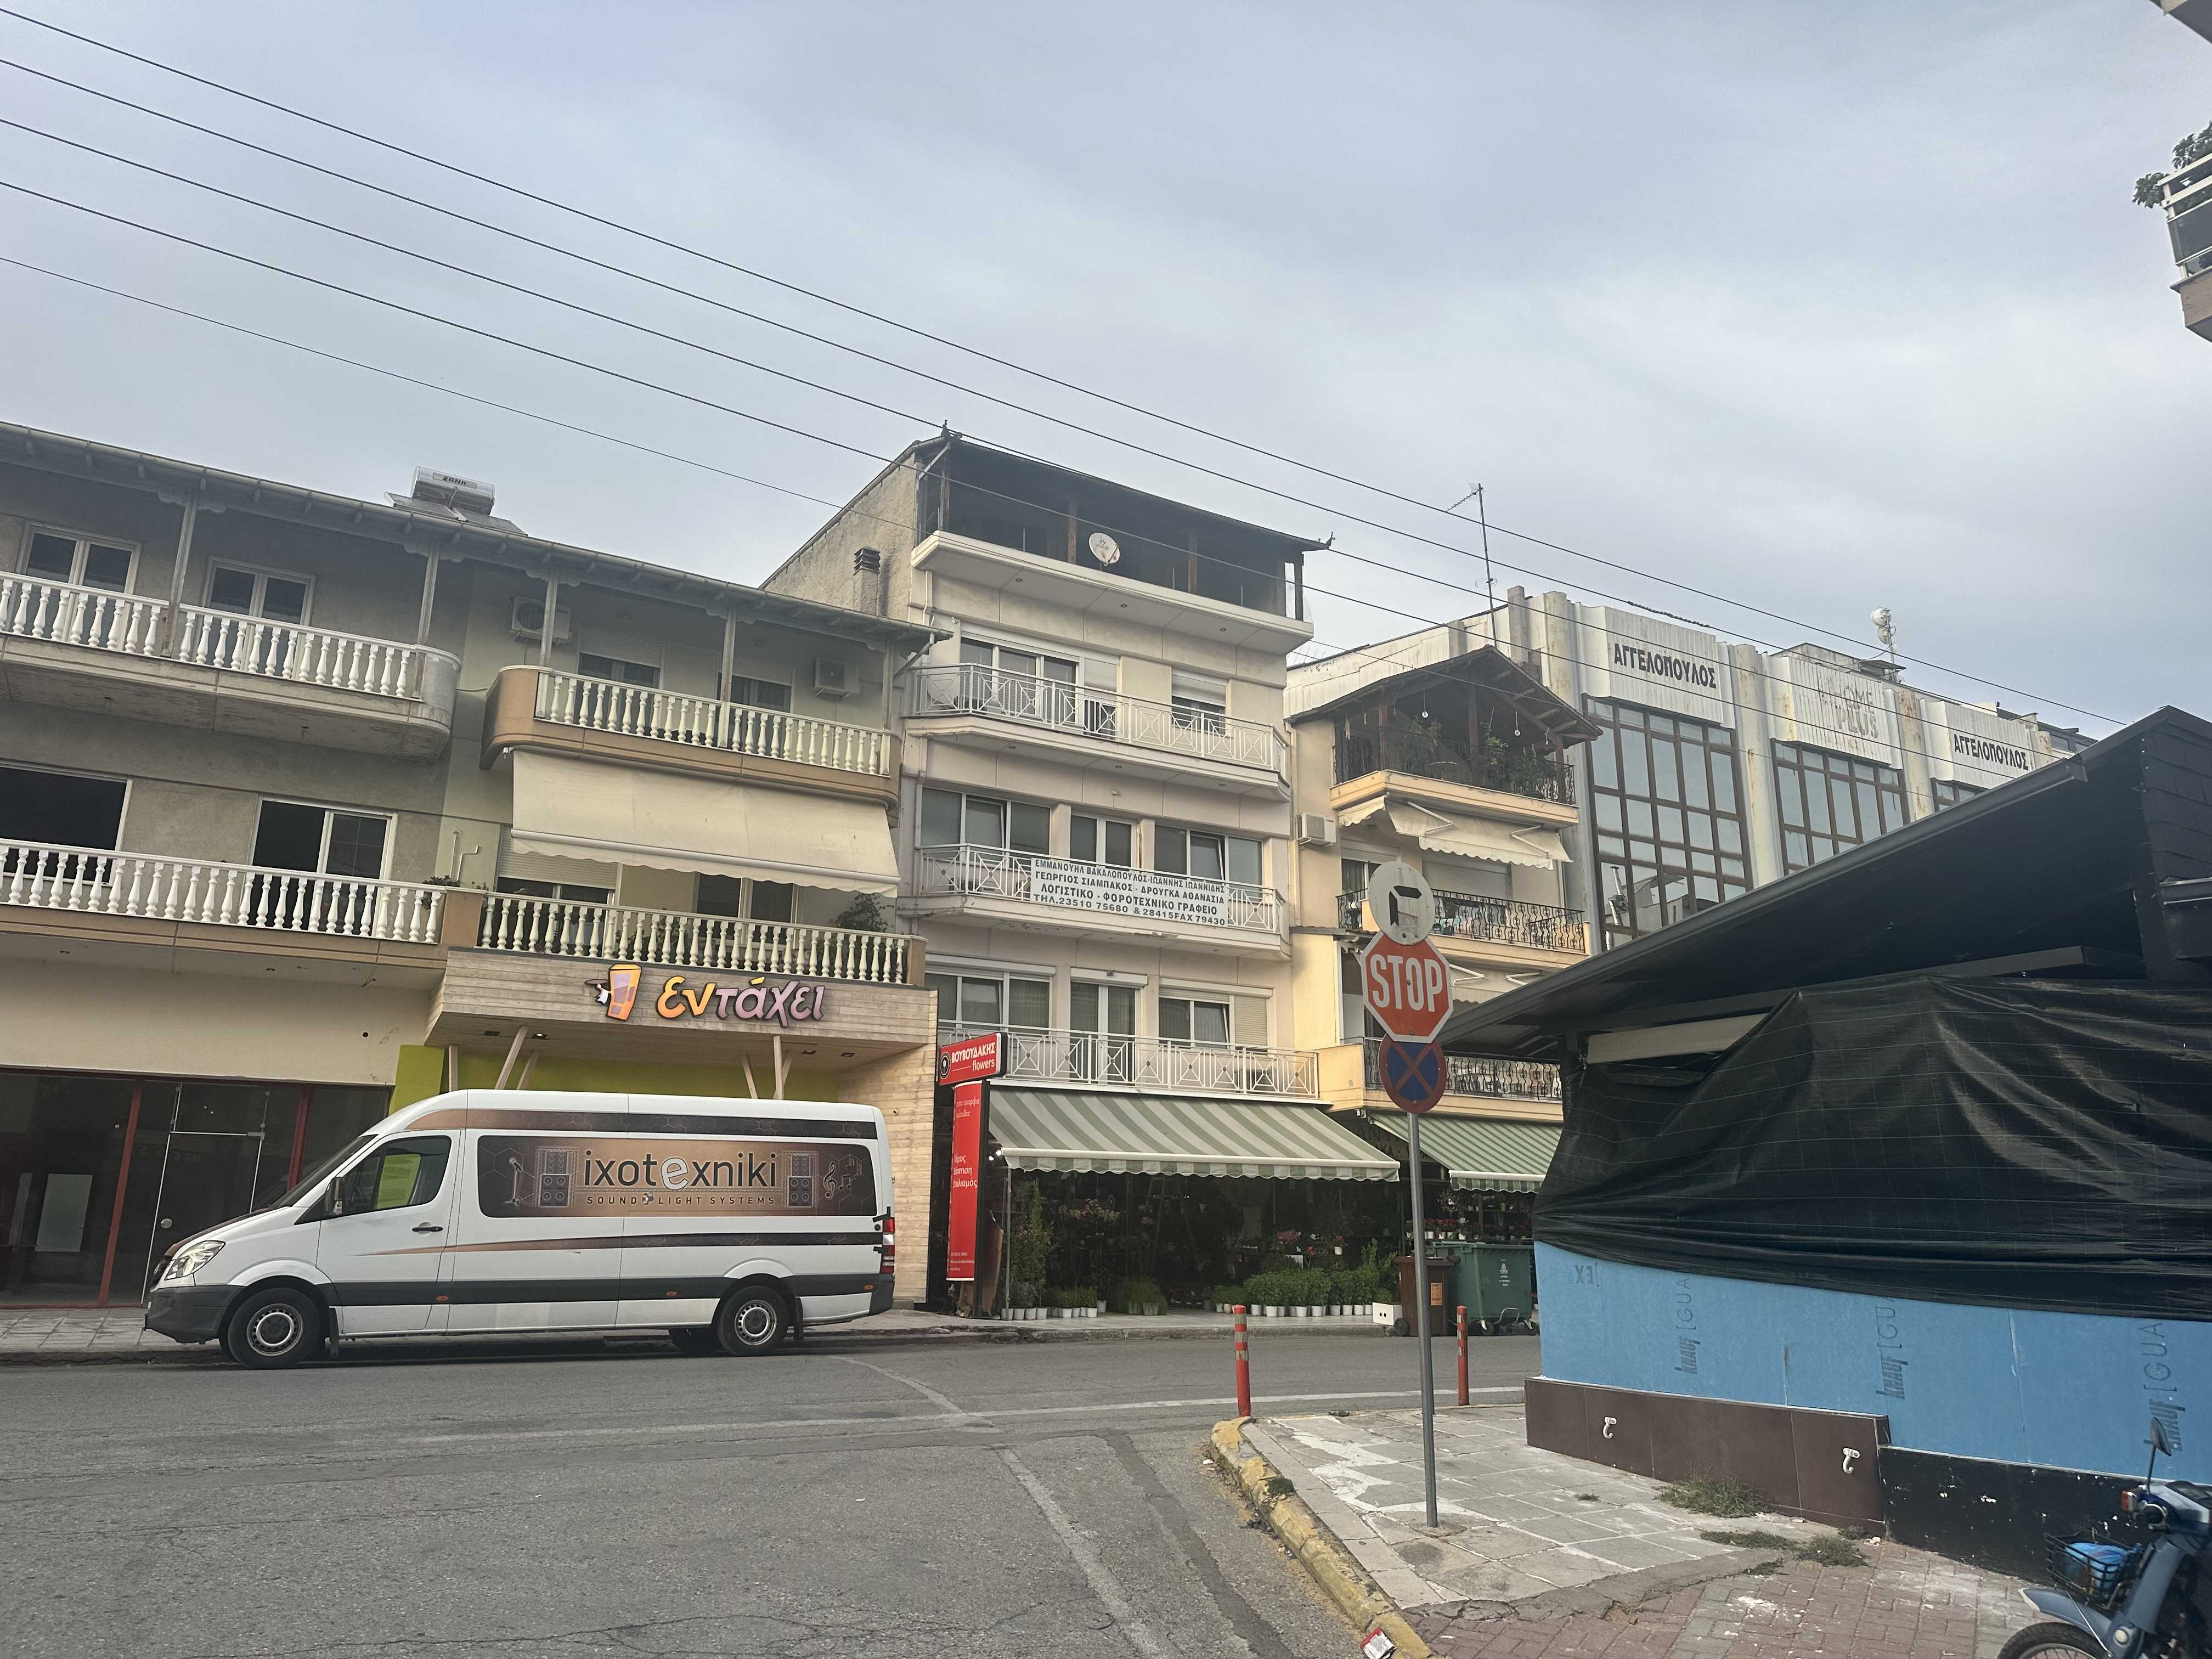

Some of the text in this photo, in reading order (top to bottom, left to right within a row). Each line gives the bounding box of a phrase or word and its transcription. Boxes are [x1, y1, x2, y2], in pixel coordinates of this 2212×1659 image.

[1614, 643, 1717, 689] ΑΓΓΕΛΟΠΟΥΛΟΣ
[1954, 734, 2029, 771] ΑΓΓΕΛΟΠΟΥΛΟΣ
[1035, 859, 1084, 873] ΕΜΜΑΝΟΥΗΛ
[1186, 881, 1225, 893] ΙΩΑΝΝΙΔΗΣ
[1036, 871, 1079, 884] ΓΕΩΡΓΙΟΣ
[1082, 878, 1133, 891] ΣΙΑΜΠΑΚΟΣ
[1141, 885, 1180, 898] ΔΡΟΥΓΚΑ
[1183, 891, 1224, 904] ΑΘΑΝΑΣΙΑ
[1041, 883, 1093, 899] ΛΟΓΙΣΤΙΚΟ
[1103, 892, 1174, 910] ΦΟΡΟΤΕΧΝΙΚΟ
[1178, 902, 1217, 915] ΓΡΑΦΕΙΟ
[1096, 902, 1128, 913] 75680
[1195, 915, 1225, 926] 79430
[1370, 953, 1443, 1013] STOP
[951, 1042, 996, 1064] ΒΟΥΒΟΥΔΑΚΗΣ
[972, 1058, 995, 1071] flowers
[584, 1150, 776, 1190] ixotexniki
[587, 1196, 774, 1205] SOUND LIGHT SYSTEMS
